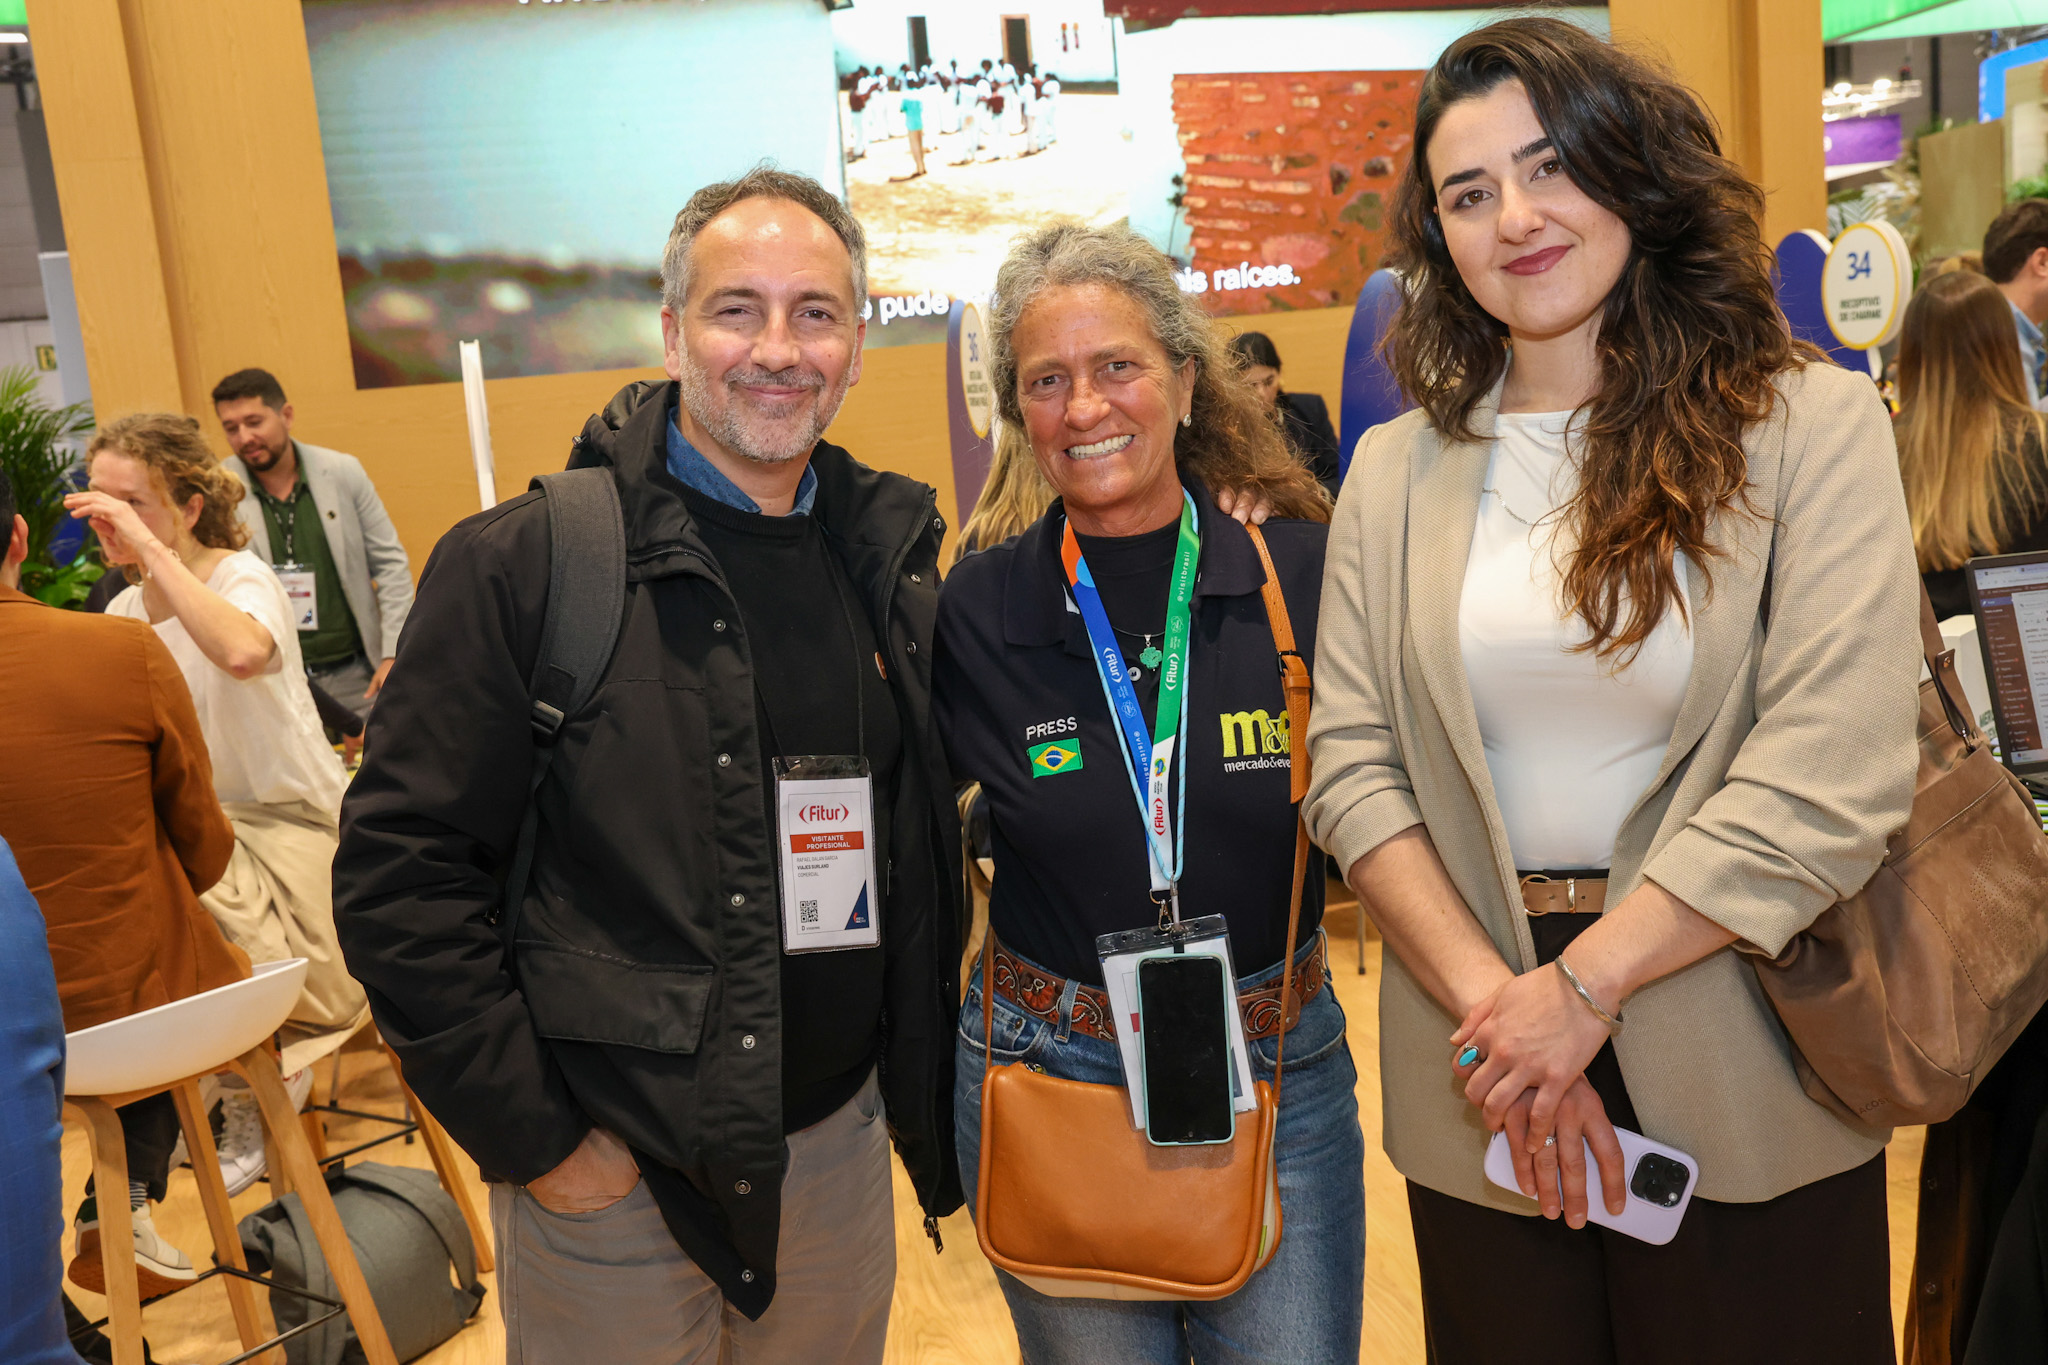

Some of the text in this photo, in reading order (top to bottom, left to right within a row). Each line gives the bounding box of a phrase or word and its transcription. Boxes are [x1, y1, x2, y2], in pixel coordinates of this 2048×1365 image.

[1174, 261, 1302, 293] is raíces.
[1846, 250, 1871, 280] 34
[879, 288, 949, 325] pude
[1177, 551, 1190, 602] @visitbrasil
[1026, 716, 1078, 741] PRESS
[806, 841, 850, 850] PROFESIONAL
[811, 834, 844, 842] VISITANTE
